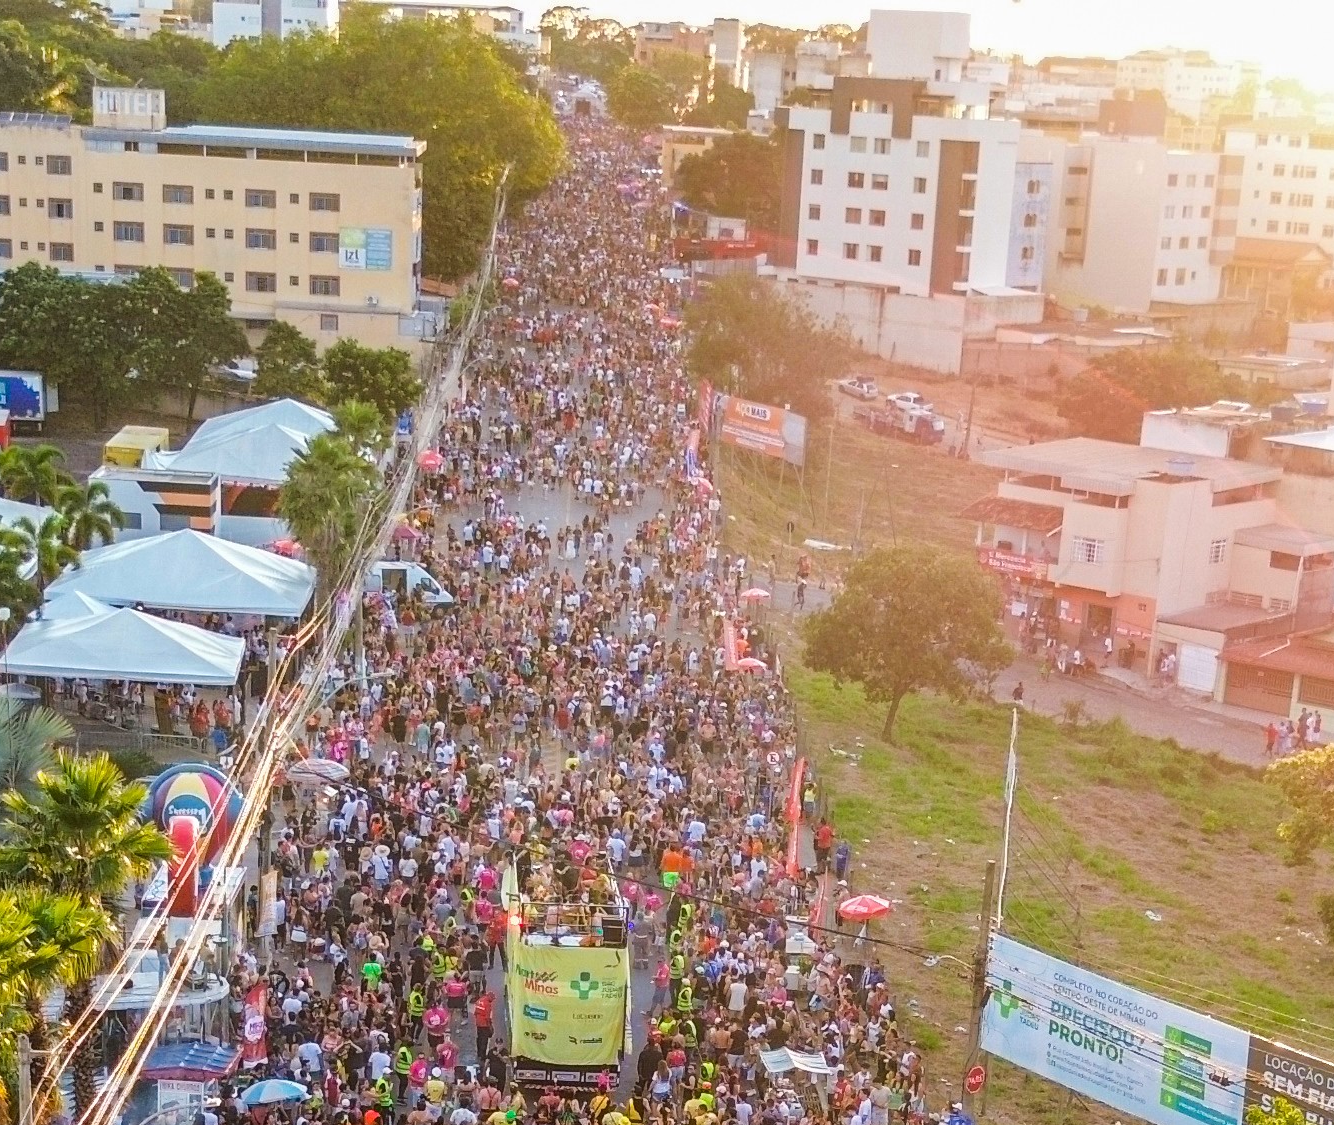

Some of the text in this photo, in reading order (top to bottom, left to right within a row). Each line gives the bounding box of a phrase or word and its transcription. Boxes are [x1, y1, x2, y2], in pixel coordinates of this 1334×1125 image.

[97, 91, 155, 115] HOTEL
[524, 979, 559, 995] Minas
[1083, 996, 1106, 1011] OESTE
[1048, 1020, 1124, 1064] PRONTO!
[1265, 1054, 1325, 1085] LOCAÇÃO
[1262, 1071, 1304, 1097] SEM
